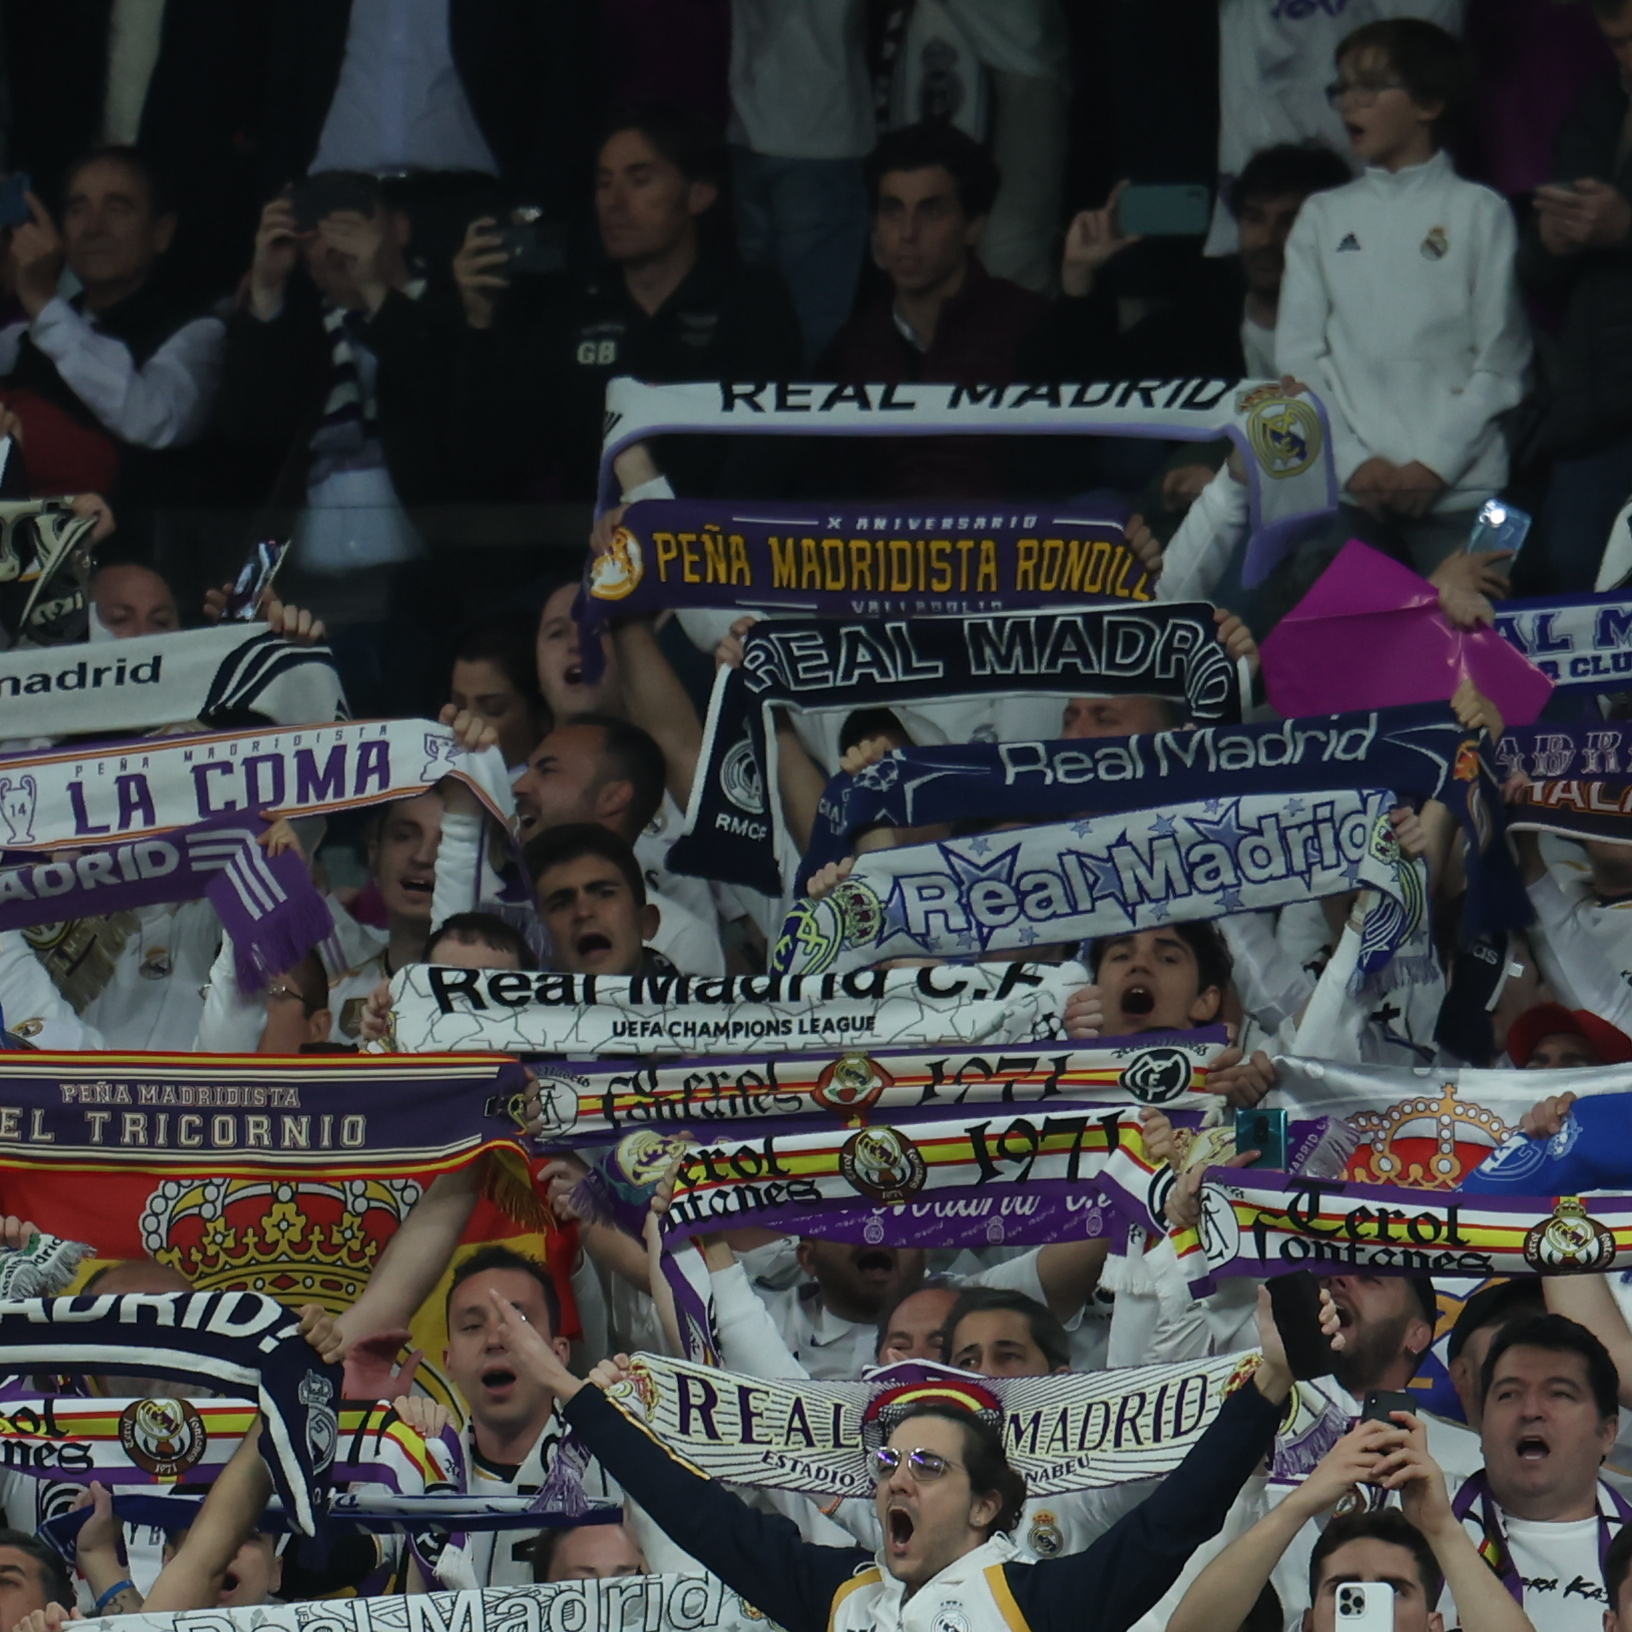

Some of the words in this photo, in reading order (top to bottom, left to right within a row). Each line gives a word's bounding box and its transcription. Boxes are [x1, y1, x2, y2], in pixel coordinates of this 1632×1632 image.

[722, 380, 916, 412] REAL
[949, 376, 1236, 410] MADRID
[856, 514, 1038, 531] ANIVERSARIO
[653, 524, 752, 586] PEÑA
[770, 535, 997, 593] MADRIDISTA
[73, 754, 151, 780] PEÑA
[183, 722, 389, 764] MADRIDISTA
[1001, 732, 1146, 787] Real
[1154, 713, 1375, 774] Madrid
[68, 773, 156, 837] LA
[193, 740, 392, 824] COMA
[903, 850, 1084, 937] Real
[1109, 798, 1372, 908] Madrid
[430, 964, 597, 1013] Real
[611, 1018, 661, 1040] UEFA
[667, 1017, 789, 1039] CHAMPIONS
[793, 1014, 876, 1035] LEAGUE
[60, 1083, 138, 1108] PEÑA
[141, 1086, 301, 1110] MADRIDISTA
[84, 1110, 368, 1149] TRICORNIO
[965, 1109, 1126, 1187] 1971
